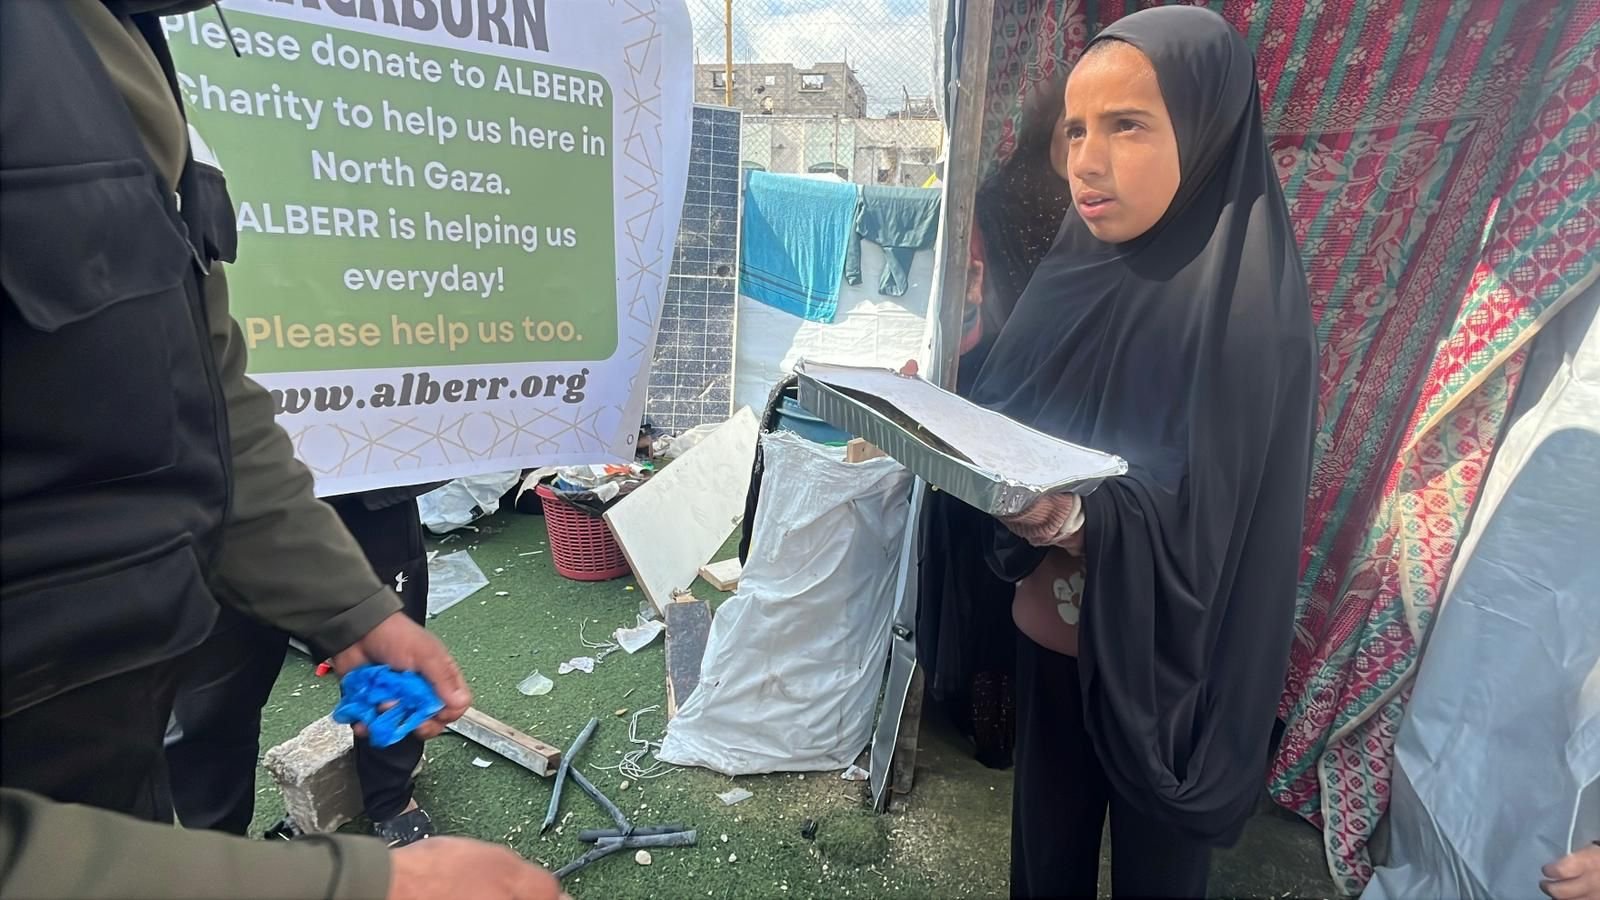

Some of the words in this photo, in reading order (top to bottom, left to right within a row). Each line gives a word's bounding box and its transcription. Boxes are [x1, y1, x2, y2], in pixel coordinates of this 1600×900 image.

[159, 11, 300, 60] Please
[311, 33, 442, 82] donate
[450, 58, 485, 88] to
[493, 64, 604, 107] ALBERR
[333, 96, 373, 128] to
[382, 99, 457, 145] help
[467, 119, 502, 144] us
[509, 117, 575, 152] here
[582, 125, 605, 156] in
[311, 150, 415, 187] North
[424, 161, 511, 195] Gaza.
[237, 201, 380, 238] ALBERR
[388, 207, 416, 239] is
[424, 211, 538, 252] helping
[546, 225, 577, 247] us
[343, 264, 505, 298] everyday!
[245, 315, 381, 349] Please
[391, 314, 469, 351] help
[478, 320, 514, 343] us
[522, 316, 583, 341] too.
[270, 368, 589, 415] ww.alberr.org
